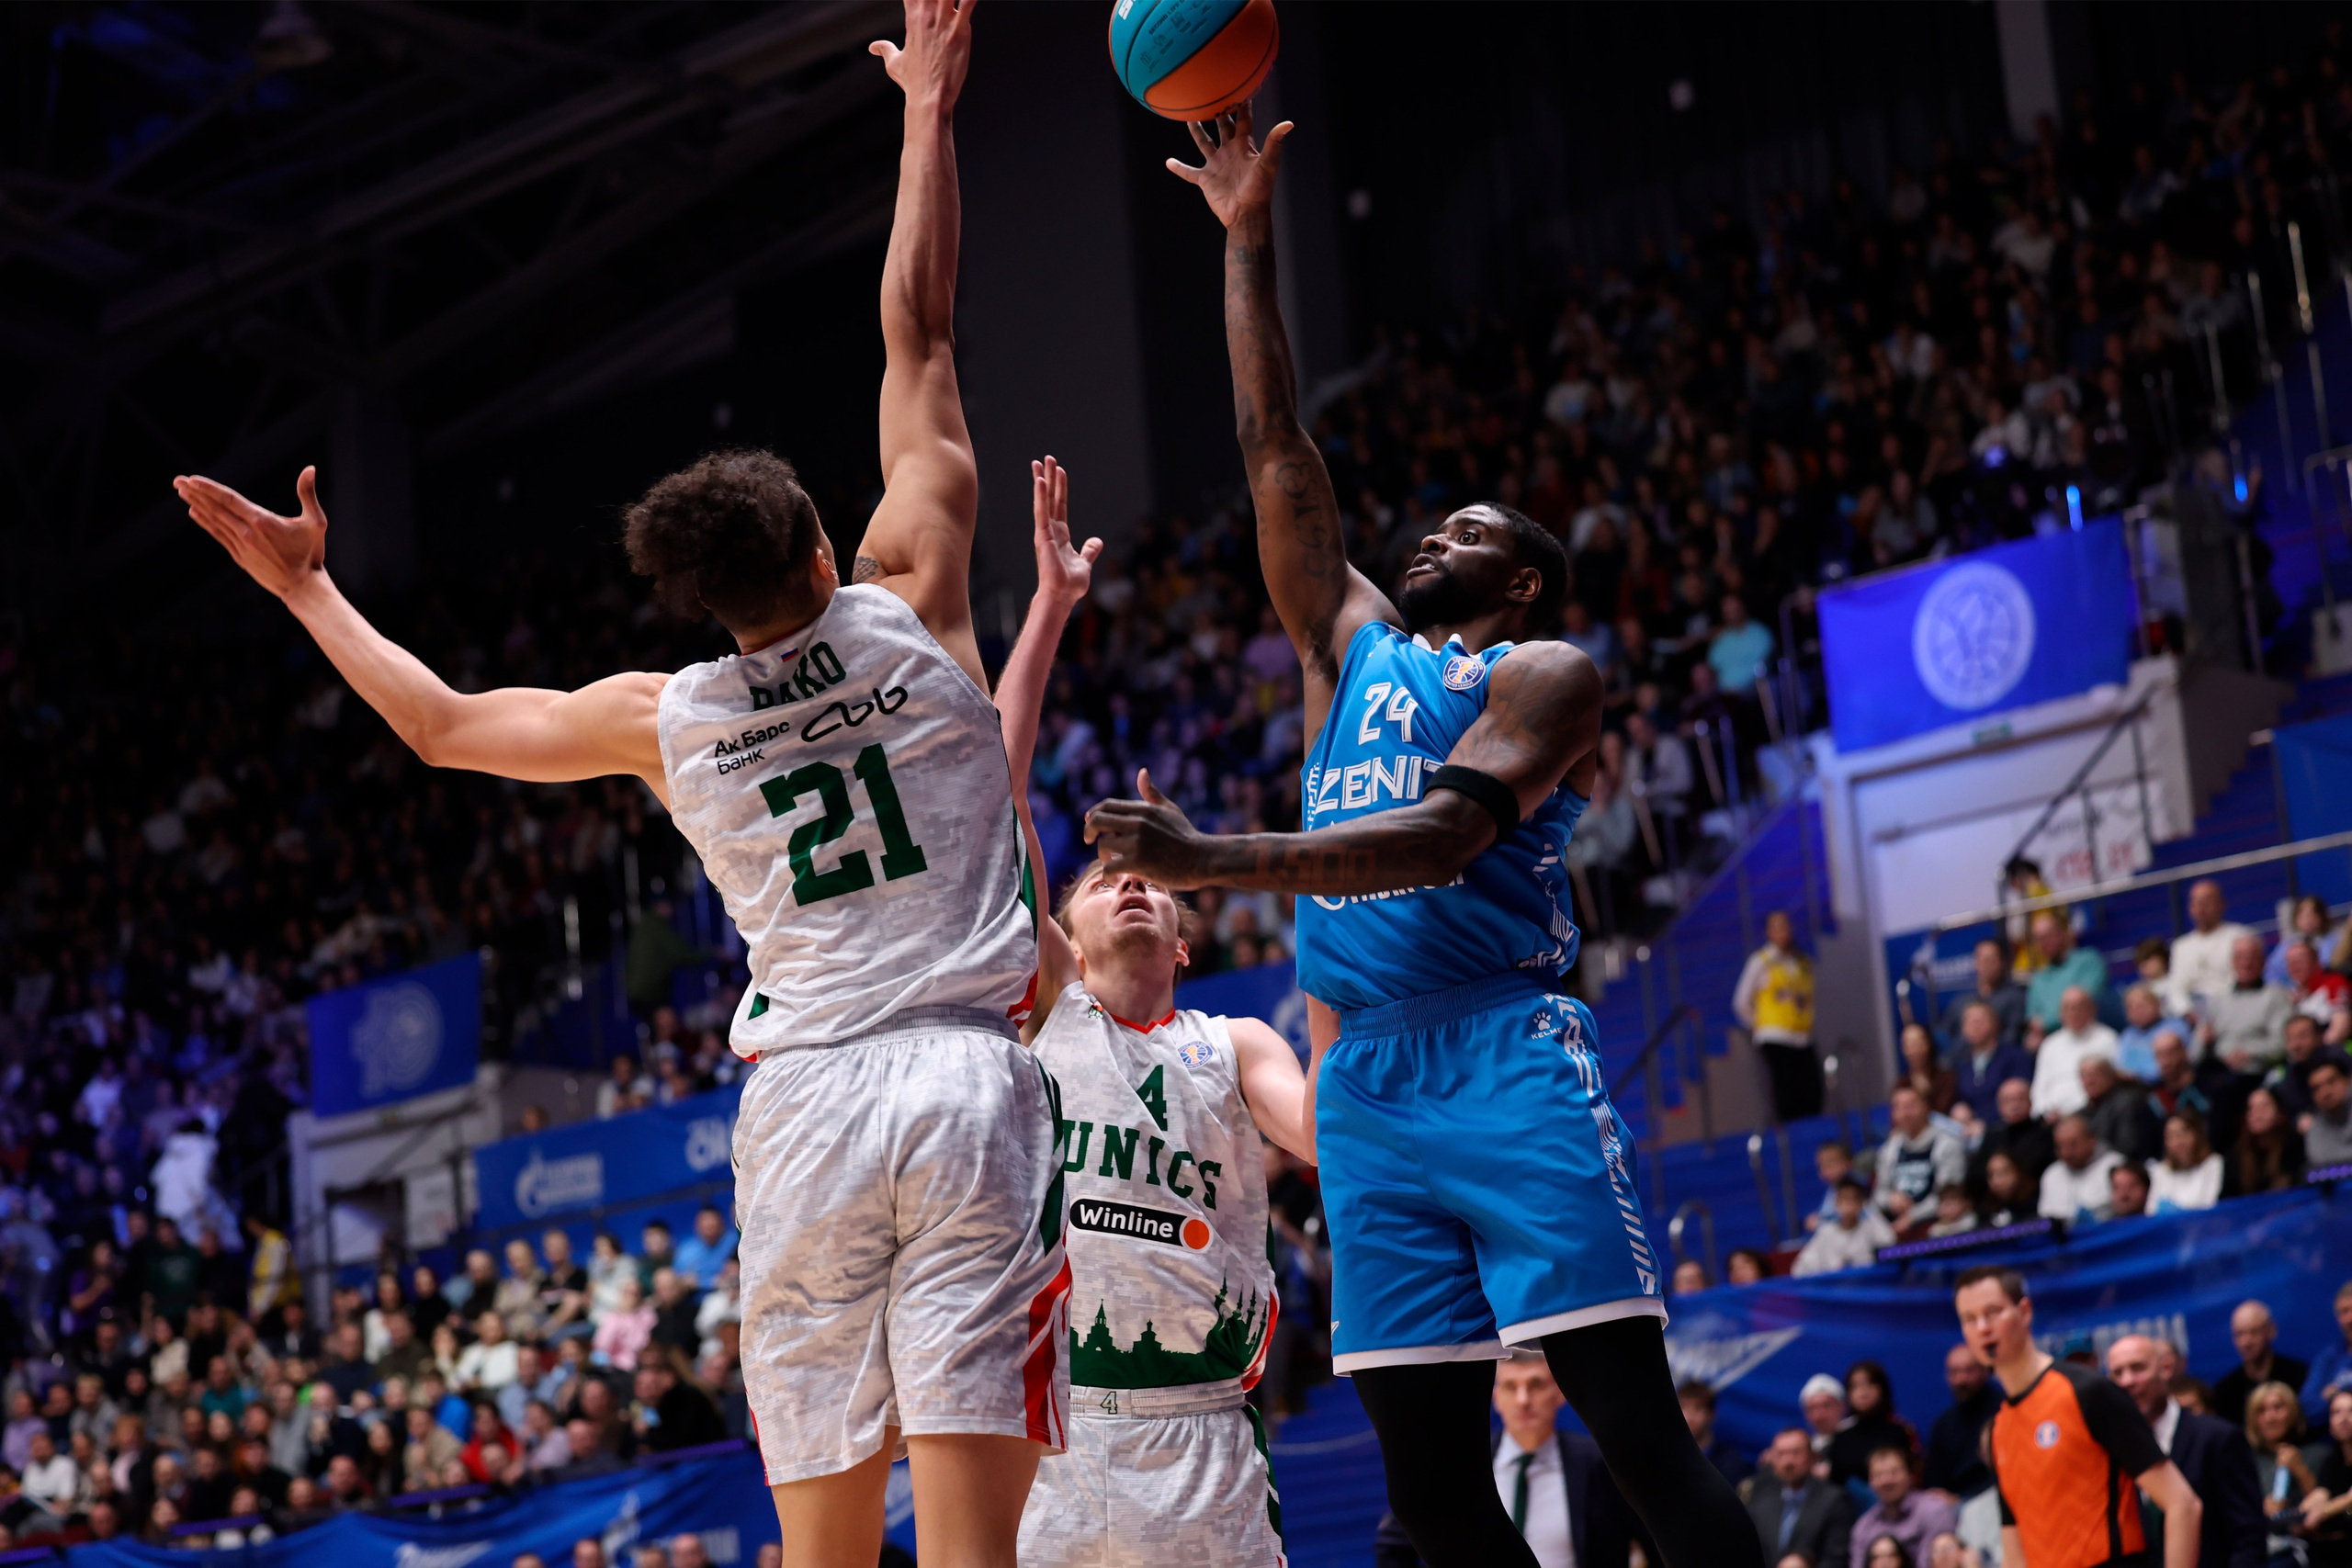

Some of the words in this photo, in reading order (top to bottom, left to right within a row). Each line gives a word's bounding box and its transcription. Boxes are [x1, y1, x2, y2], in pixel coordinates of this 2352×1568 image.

[1359, 682, 1419, 746] 24
[714, 740, 741, 758] Ак
[741, 721, 790, 749] Барс
[718, 749, 765, 775] Банк
[759, 742, 928, 907] 21
[1531, 1027, 1563, 1040] KELME
[1136, 1065, 1168, 1132] 4
[1064, 1120, 1222, 1211] UNICS
[1079, 1203, 1174, 1238] Winline
[1100, 1392, 1118, 1415] 4
